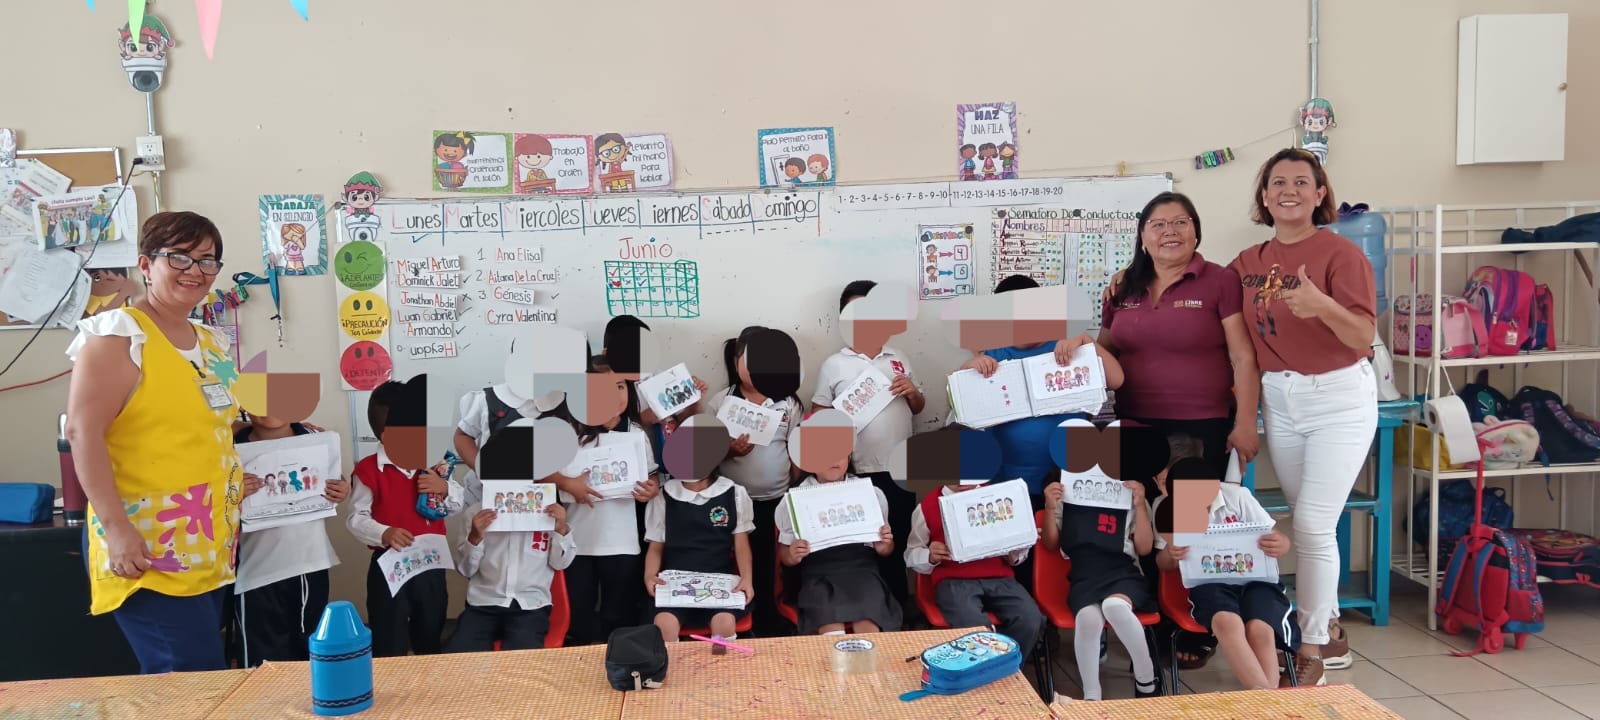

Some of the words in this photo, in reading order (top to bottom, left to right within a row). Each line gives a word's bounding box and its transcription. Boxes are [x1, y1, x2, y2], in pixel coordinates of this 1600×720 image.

[974, 109, 1000, 121] HAZ
[970, 123, 986, 135] UNA
[987, 123, 1005, 134] FILA
[272, 212, 282, 222] EN
[283, 211, 314, 222] SILENCIO
[392, 206, 442, 230] Lunes
[445, 206, 499, 229] Martes
[503, 202, 580, 228] Miercoles
[650, 202, 699, 224] iernes
[1003, 218, 1046, 232] Nombres
[496, 247, 515, 261] Ana
[517, 247, 541, 262] Elisa
[618, 237, 673, 260] Junio
[396, 256, 430, 274] Miguel
[431, 256, 460, 271] Arturo
[397, 273, 435, 287] Dominick
[514, 270, 525, 283] De
[525, 269, 536, 282] La
[400, 291, 434, 306] Jonathan
[434, 293, 457, 308] Abdiel
[493, 286, 532, 303] Génesis
[396, 310, 421, 323] Luan
[422, 308, 458, 321] Gabriel
[486, 308, 514, 325] Cyra
[515, 308, 557, 323] Valentina
[407, 321, 452, 336] Armando
